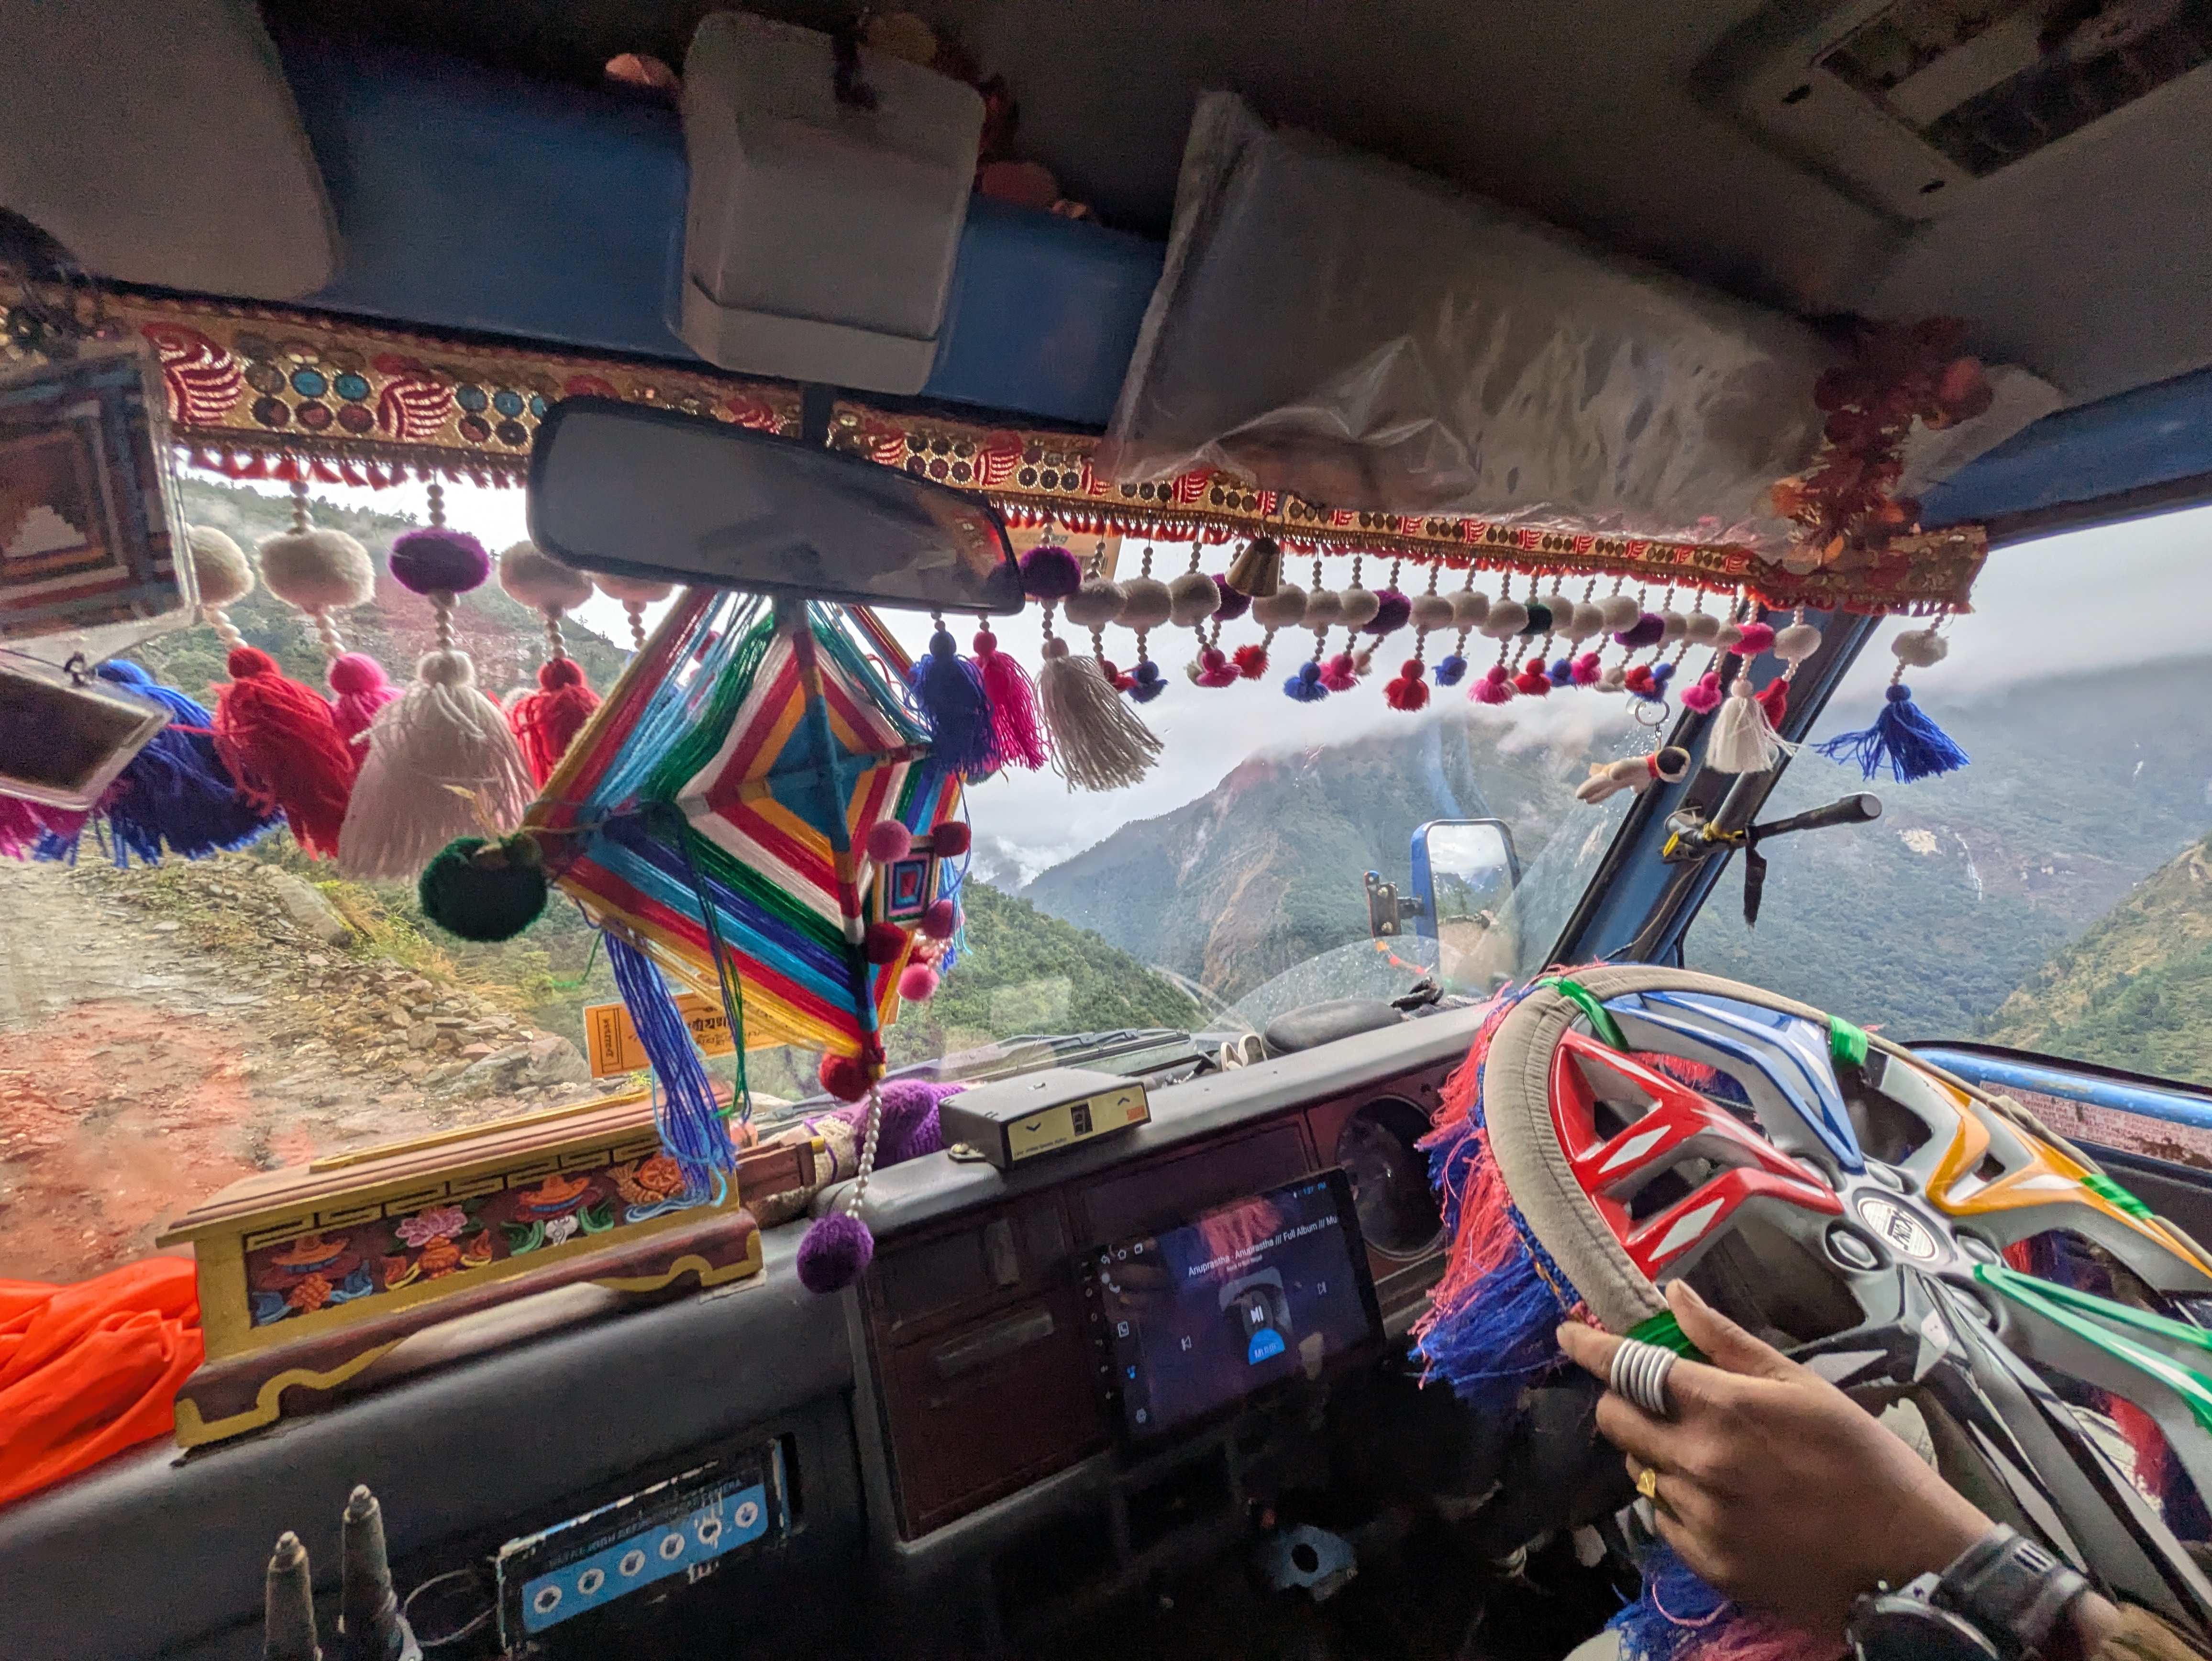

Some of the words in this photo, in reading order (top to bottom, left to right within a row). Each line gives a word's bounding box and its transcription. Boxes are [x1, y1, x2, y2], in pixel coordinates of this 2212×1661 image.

[1189, 1255, 1229, 1276] Anuprastha
[1235, 1238, 1274, 1259] Anuprastha
[1283, 1228, 1295, 1241] Full
[1297, 1223, 1317, 1237] Album
[1326, 1216, 1338, 1225] Mu
